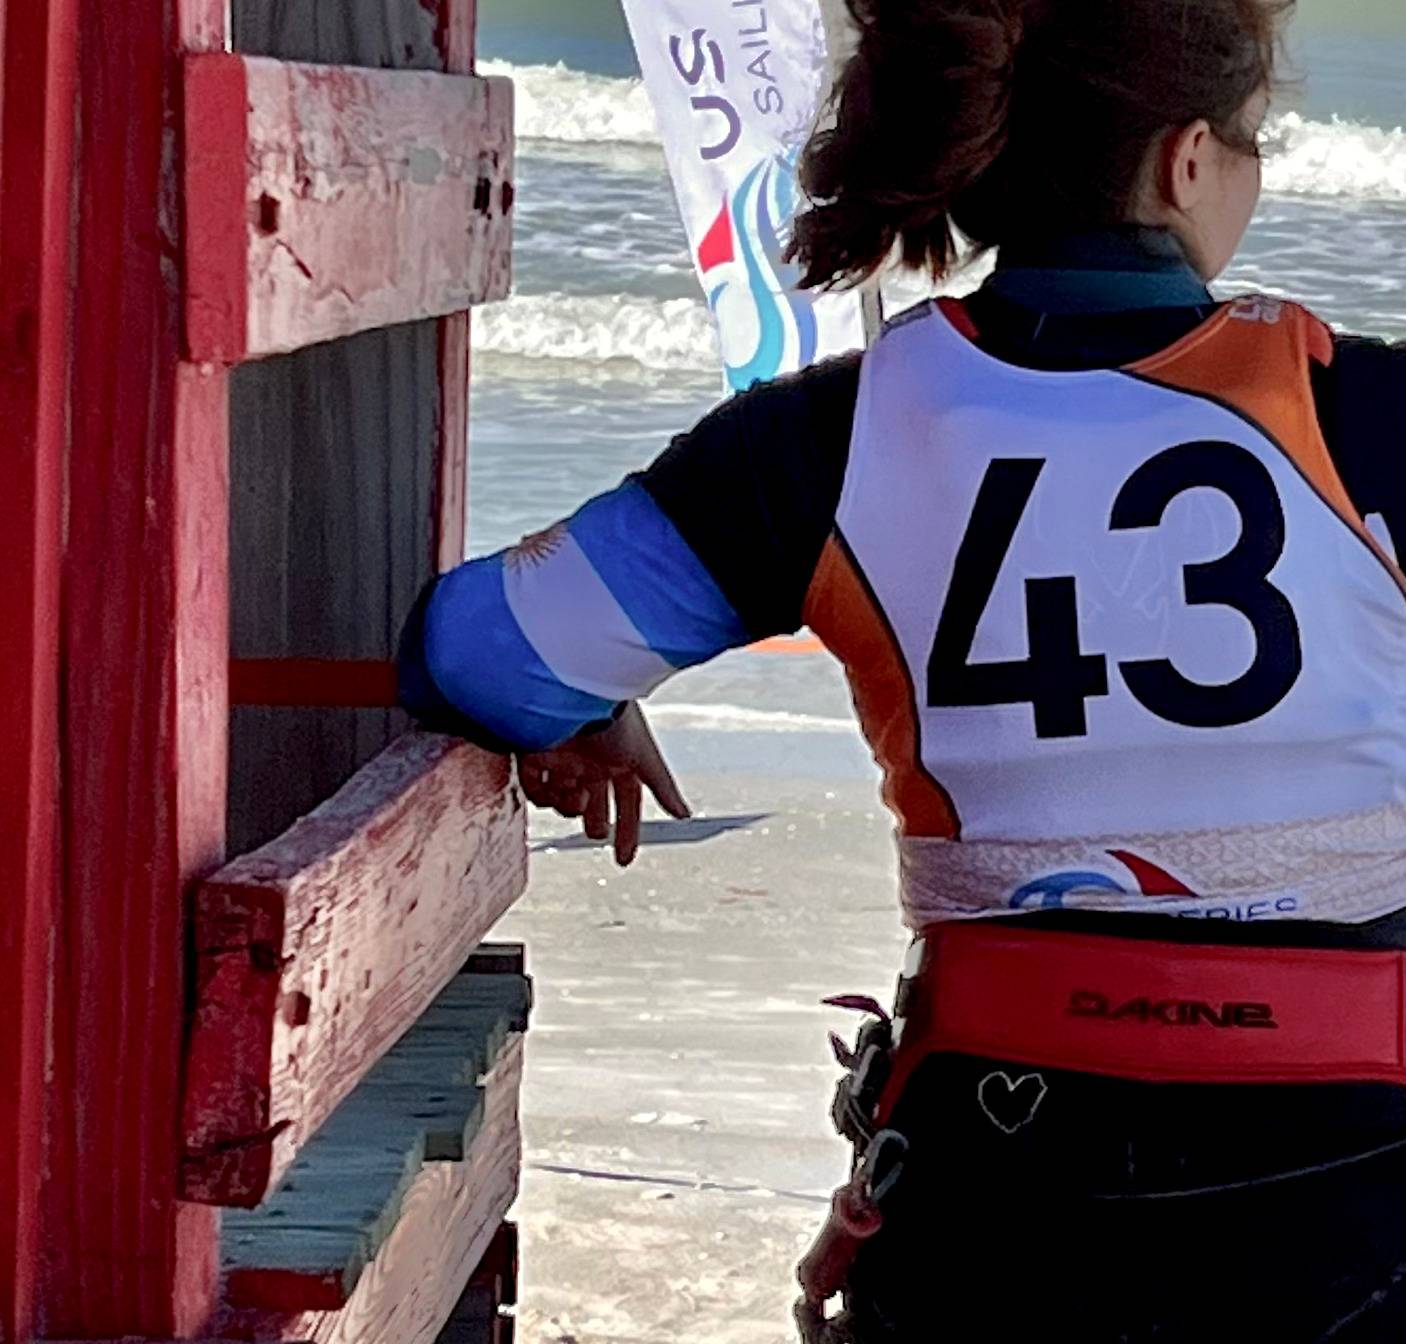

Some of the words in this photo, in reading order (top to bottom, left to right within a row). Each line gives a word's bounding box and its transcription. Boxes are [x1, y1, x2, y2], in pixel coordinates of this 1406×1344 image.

[671, 27, 742, 161] US
[926, 439, 1303, 739] 43
[1066, 991, 1279, 1030] DAKINE
